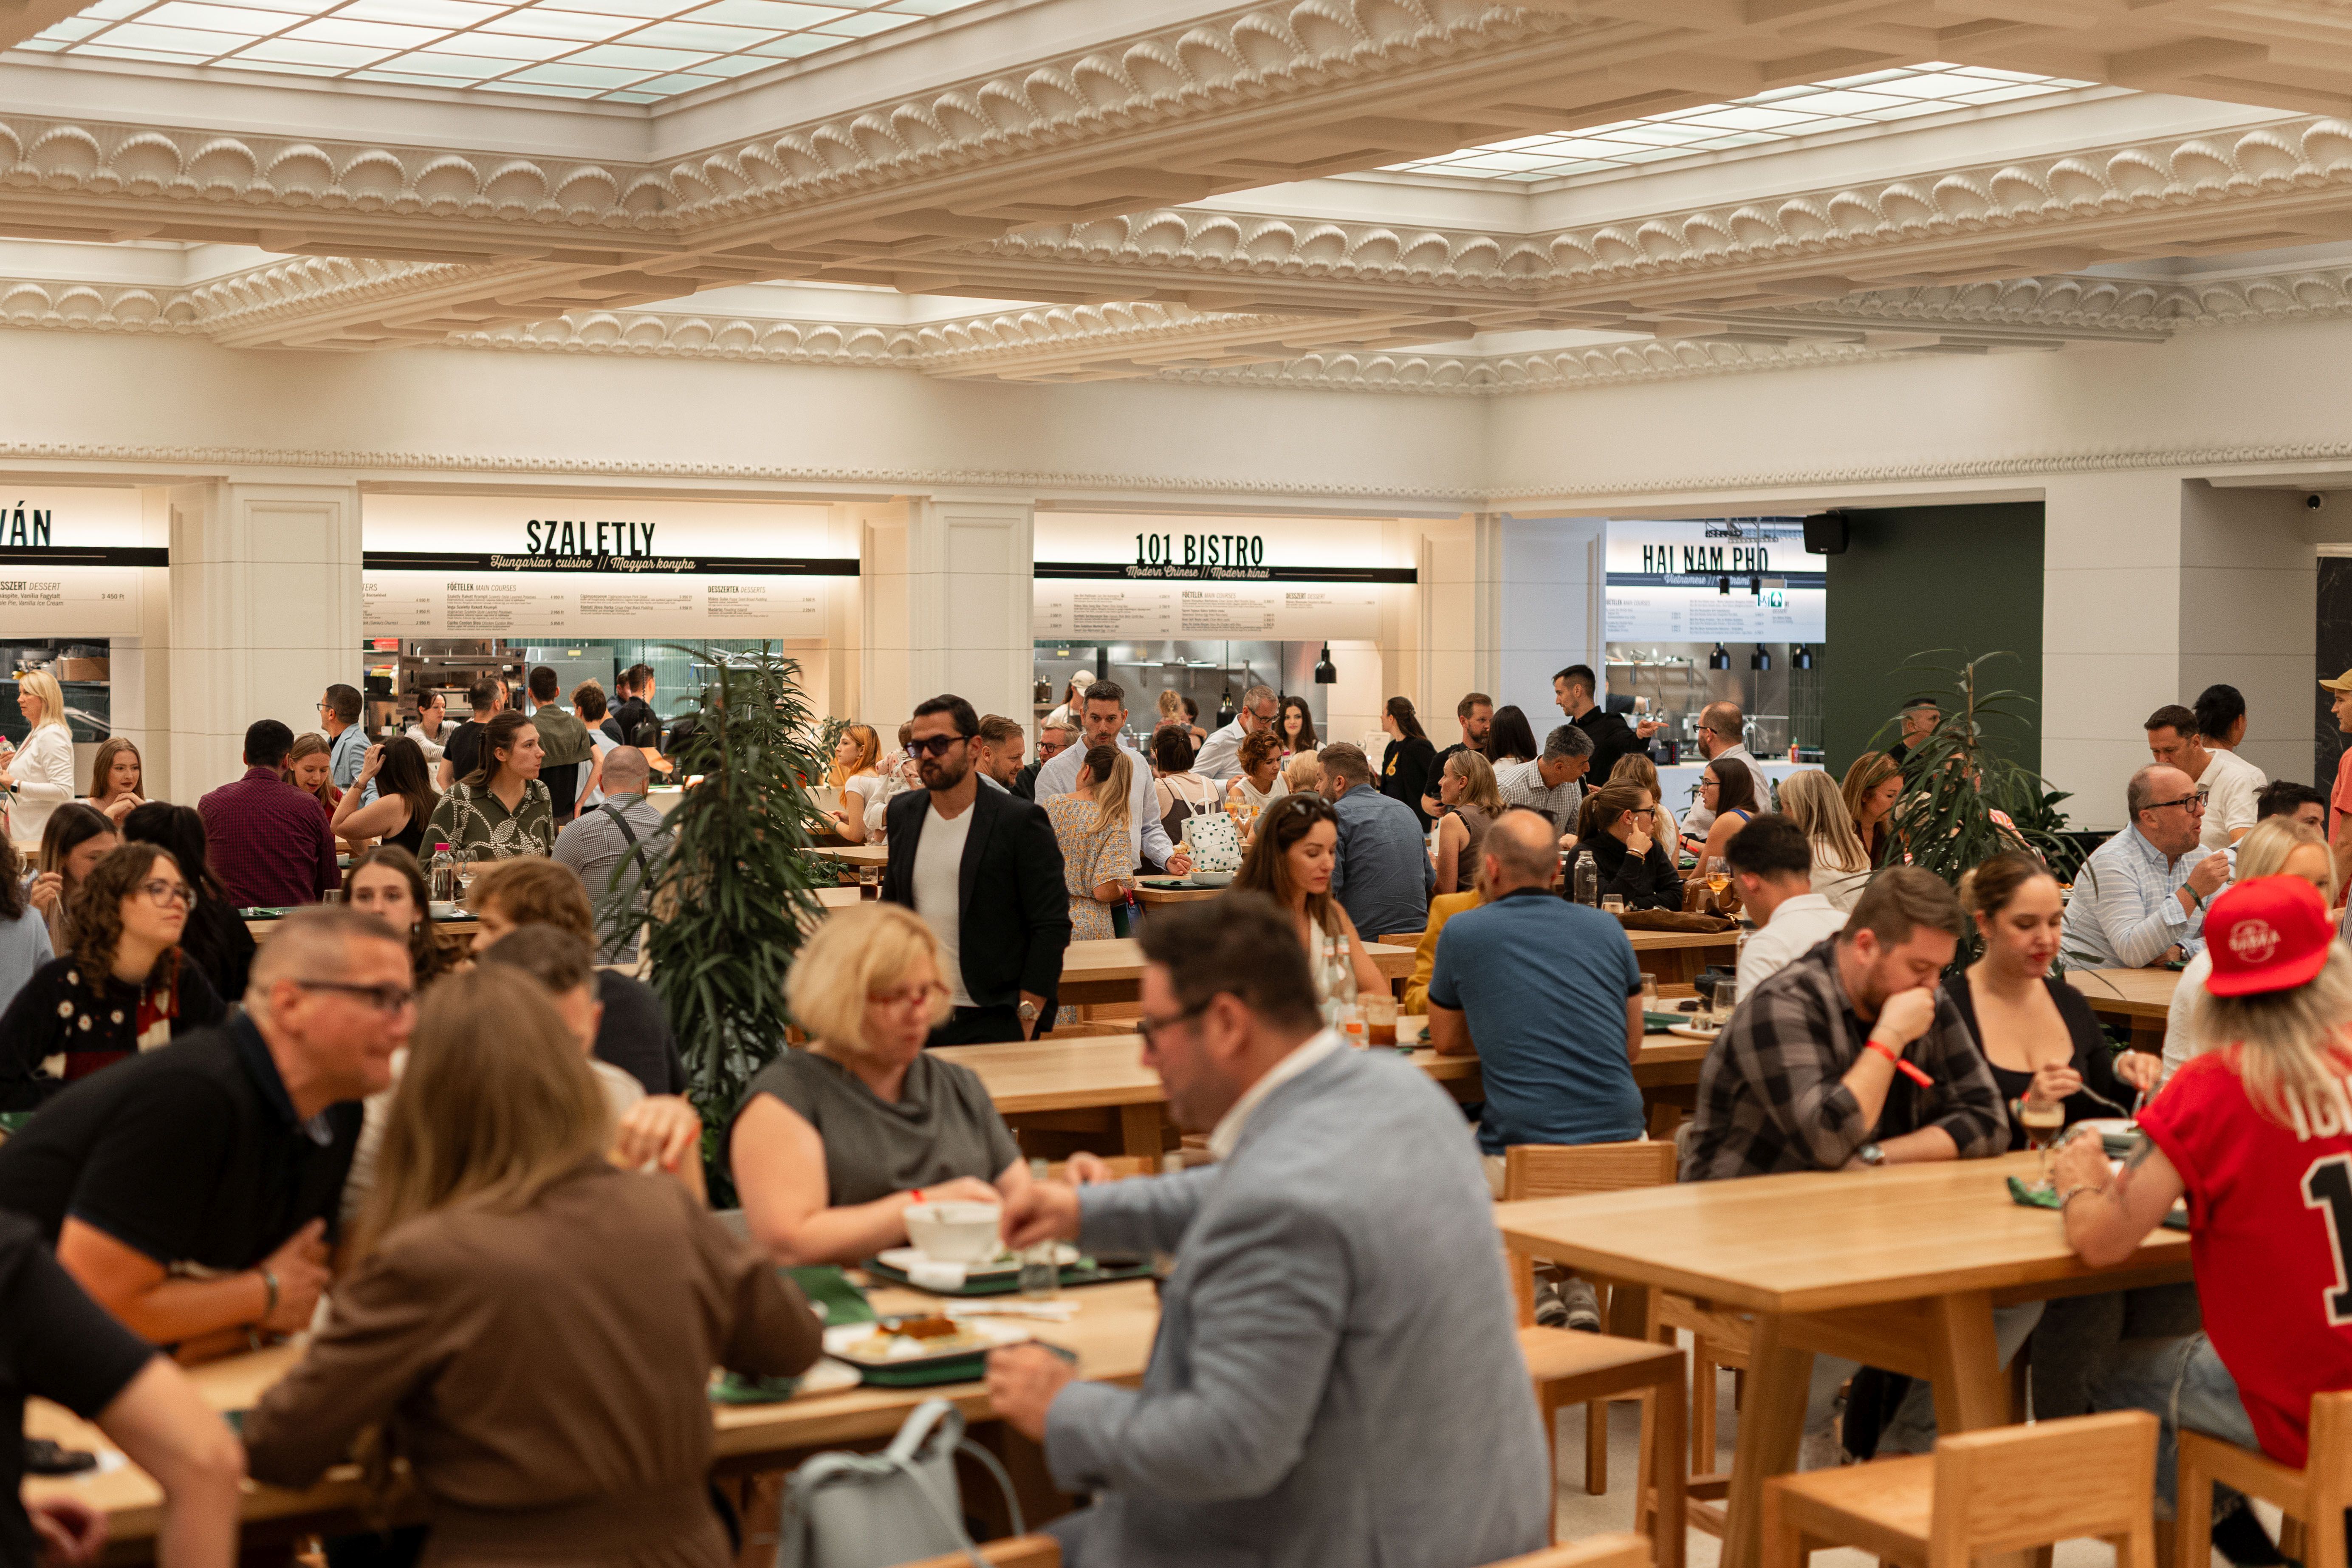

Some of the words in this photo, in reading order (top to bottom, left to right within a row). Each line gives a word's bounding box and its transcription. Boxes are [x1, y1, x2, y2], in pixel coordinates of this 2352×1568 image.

[527, 520, 655, 556] SZALETLY
[1136, 533, 1172, 565] 101
[1185, 534, 1263, 566] BISTRO
[1643, 544, 1674, 573] HAI
[1684, 545, 1724, 571] NAM
[1734, 547, 1768, 571] PHO
[490, 554, 552, 571] Hungarian
[555, 556, 593, 568] cuisine
[610, 557, 656, 572] Magyar
[656, 557, 696, 572] konyha
[1126, 565, 1163, 578] Modern
[1164, 565, 1199, 577] Chinese
[1211, 568, 1247, 579] Modern
[0, 581, 27, 590] SSZERT
[29, 582, 61, 590] DESSERT
[447, 582, 474, 591] FŐÉTELEK
[1663, 573, 1707, 585] Vietnamese
[2299, 1150, 2352, 1328] 1
